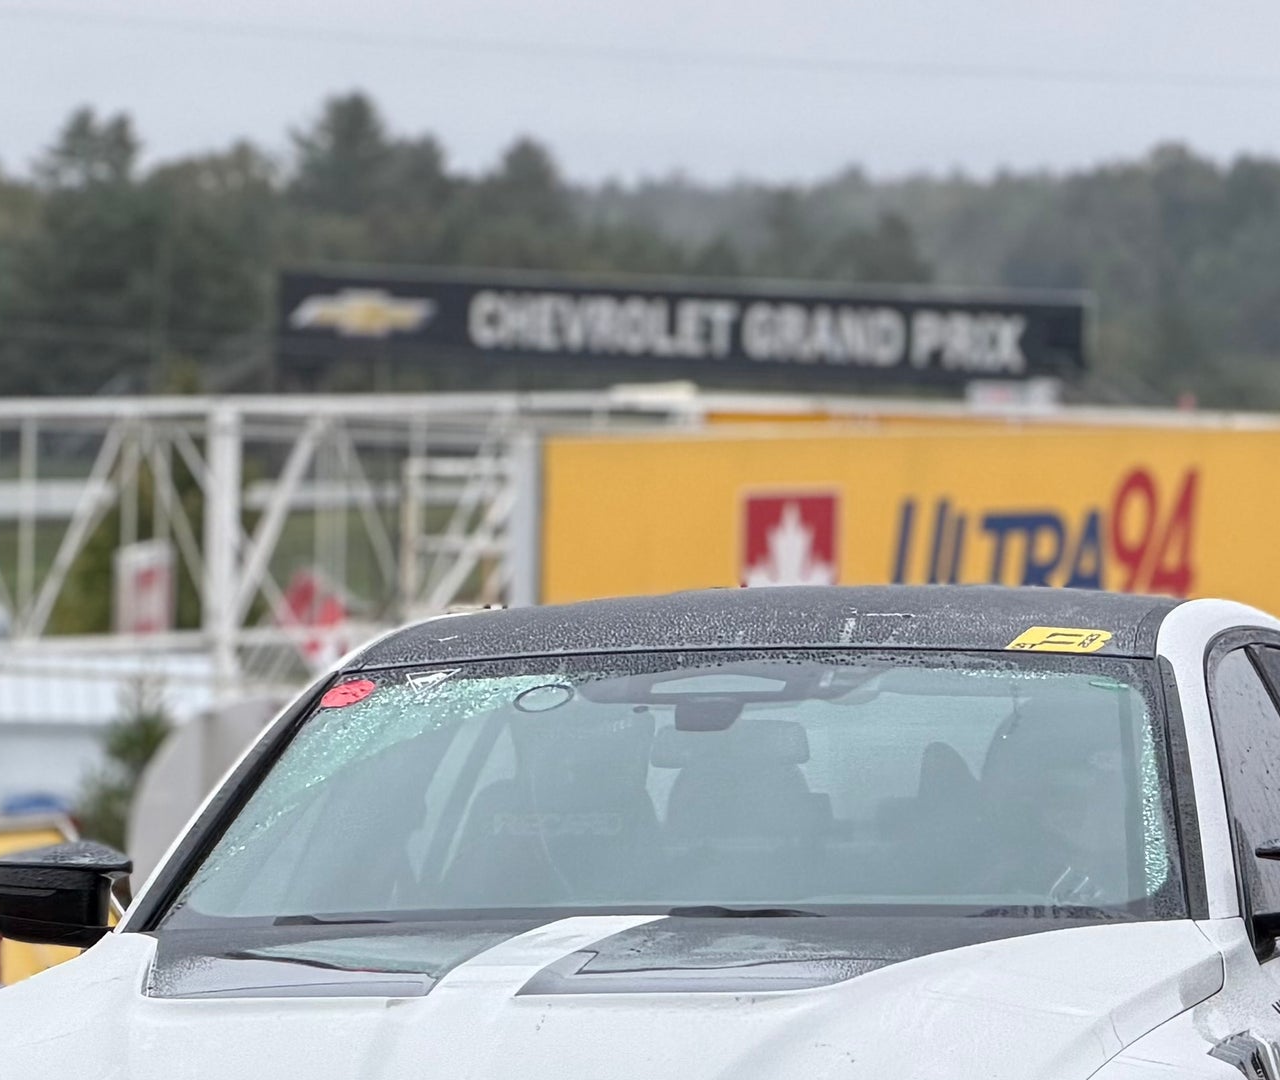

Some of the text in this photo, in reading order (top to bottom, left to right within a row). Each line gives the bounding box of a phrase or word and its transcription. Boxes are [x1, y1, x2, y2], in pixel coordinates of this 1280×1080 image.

[468, 290, 1026, 372] CHEVROLET GRAND PRIX
